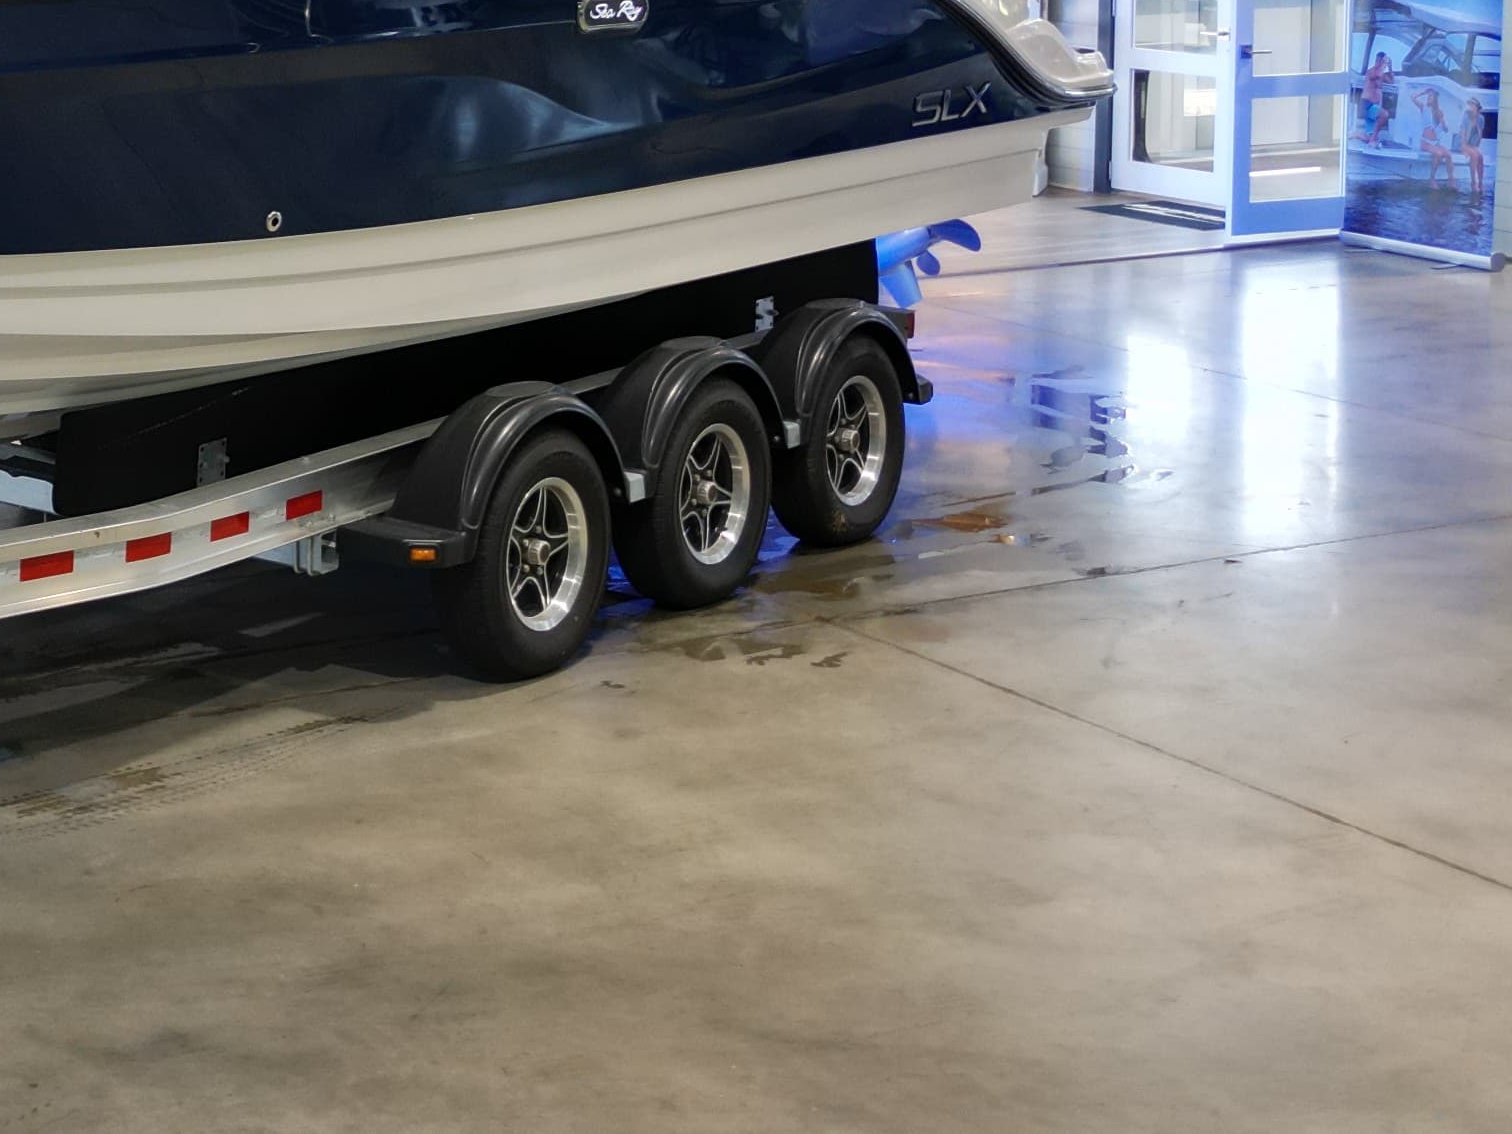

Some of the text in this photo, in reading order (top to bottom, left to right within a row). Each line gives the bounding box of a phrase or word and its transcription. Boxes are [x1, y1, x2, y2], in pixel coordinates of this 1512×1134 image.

[590, 0, 644, 22] Sea Ray
[911, 82, 992, 127] SLX
